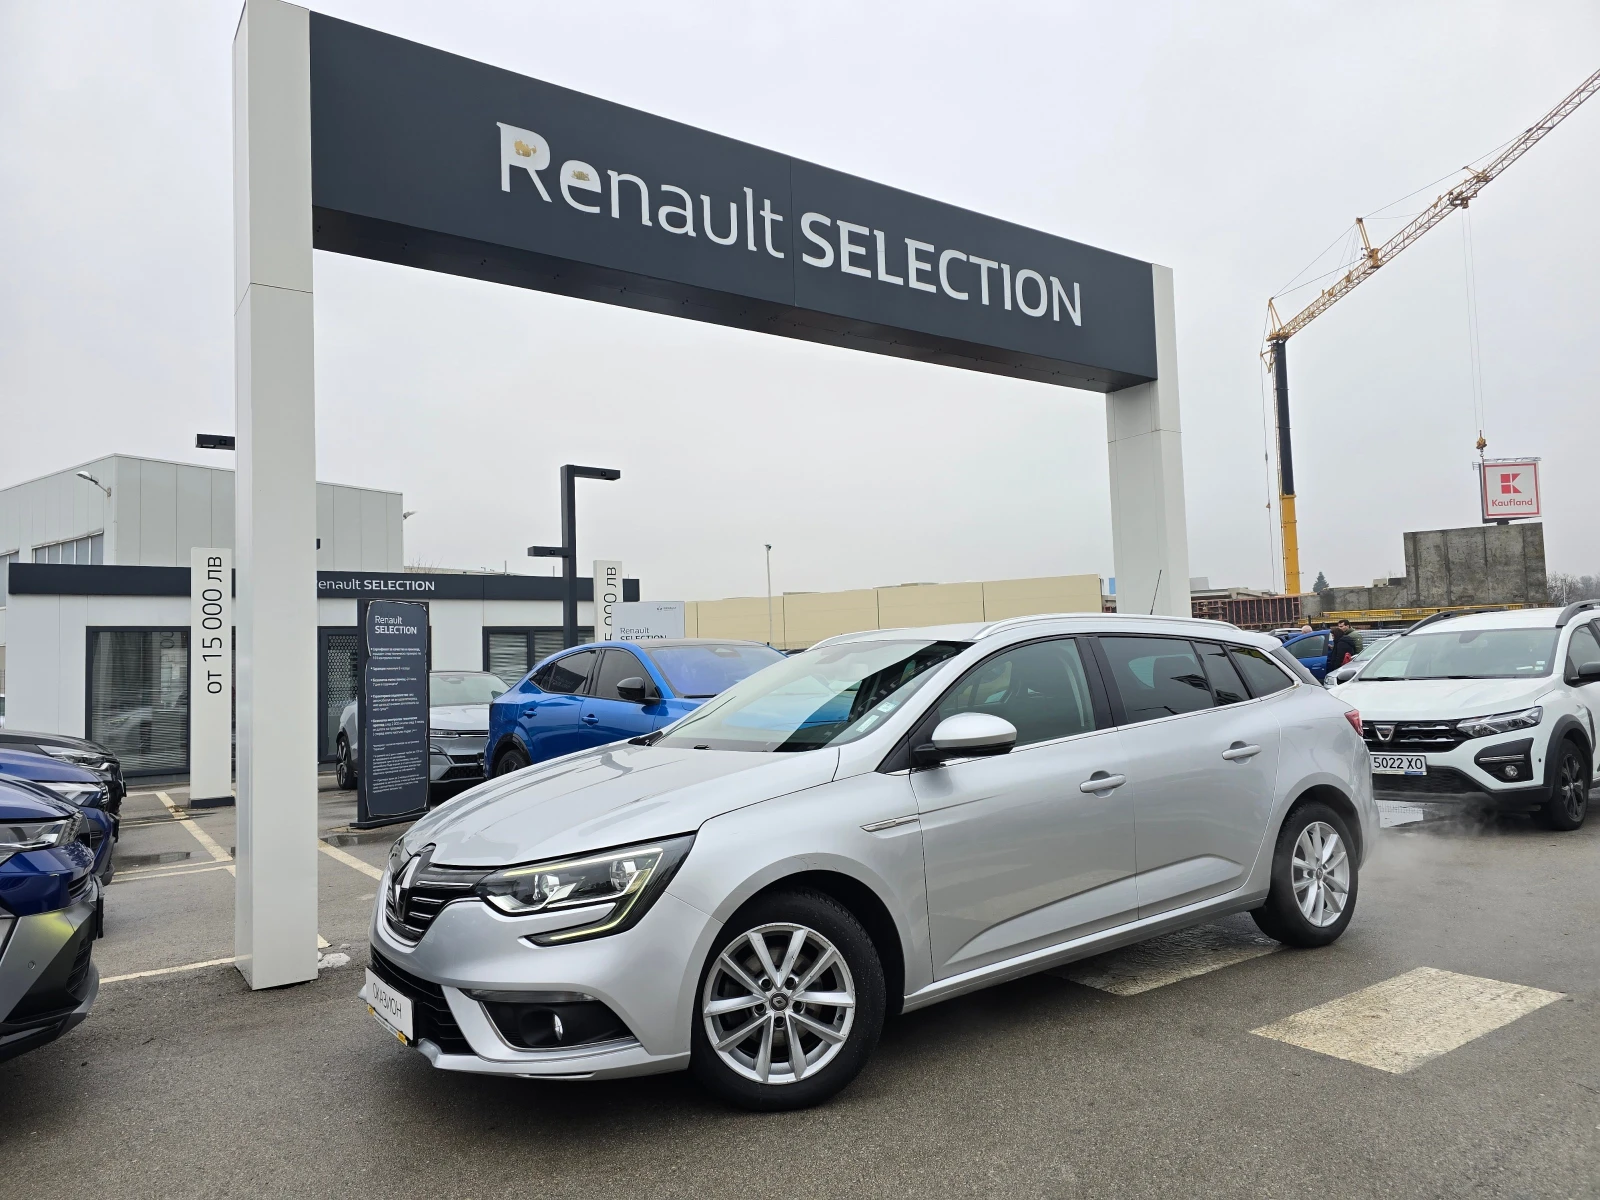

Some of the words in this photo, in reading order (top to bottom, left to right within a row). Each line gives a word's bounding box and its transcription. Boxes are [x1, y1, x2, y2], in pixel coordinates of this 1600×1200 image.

[496, 121, 785, 259] Renault
[800, 211, 1082, 327] SELECTION
[1491, 498, 1533, 507] Kaufland
[318, 579, 361, 590] enault
[363, 580, 435, 591] SELECTION
[202, 588, 222, 630] 000
[374, 615, 403, 624] Renault
[374, 625, 417, 635] SELECTION
[202, 637, 222, 662] 15
[1373, 756, 1404, 769] 5022
[1406, 757, 1423, 770] XO
